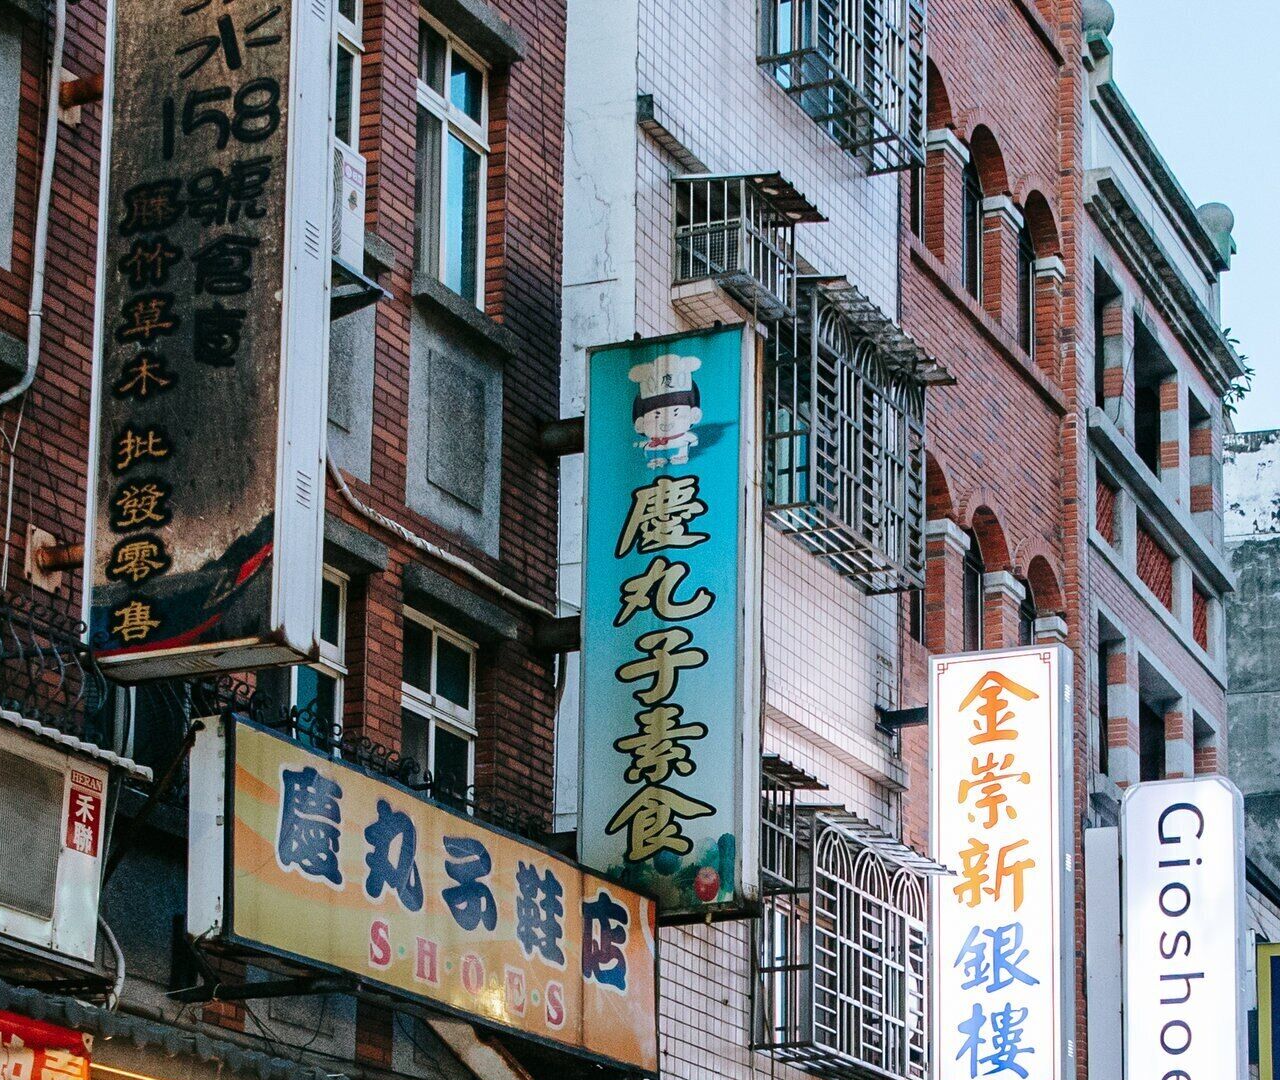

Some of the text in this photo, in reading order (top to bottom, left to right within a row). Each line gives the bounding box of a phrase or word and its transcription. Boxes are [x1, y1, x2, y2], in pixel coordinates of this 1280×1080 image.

[70, 769, 103, 793] HERAN
[605, 474, 718, 863] 慶丸子素食
[73, 794, 97, 853] 禾聯
[276, 764, 631, 992] 慶丸子鞋店
[952, 670, 1041, 1080] 金崇新銀樓
